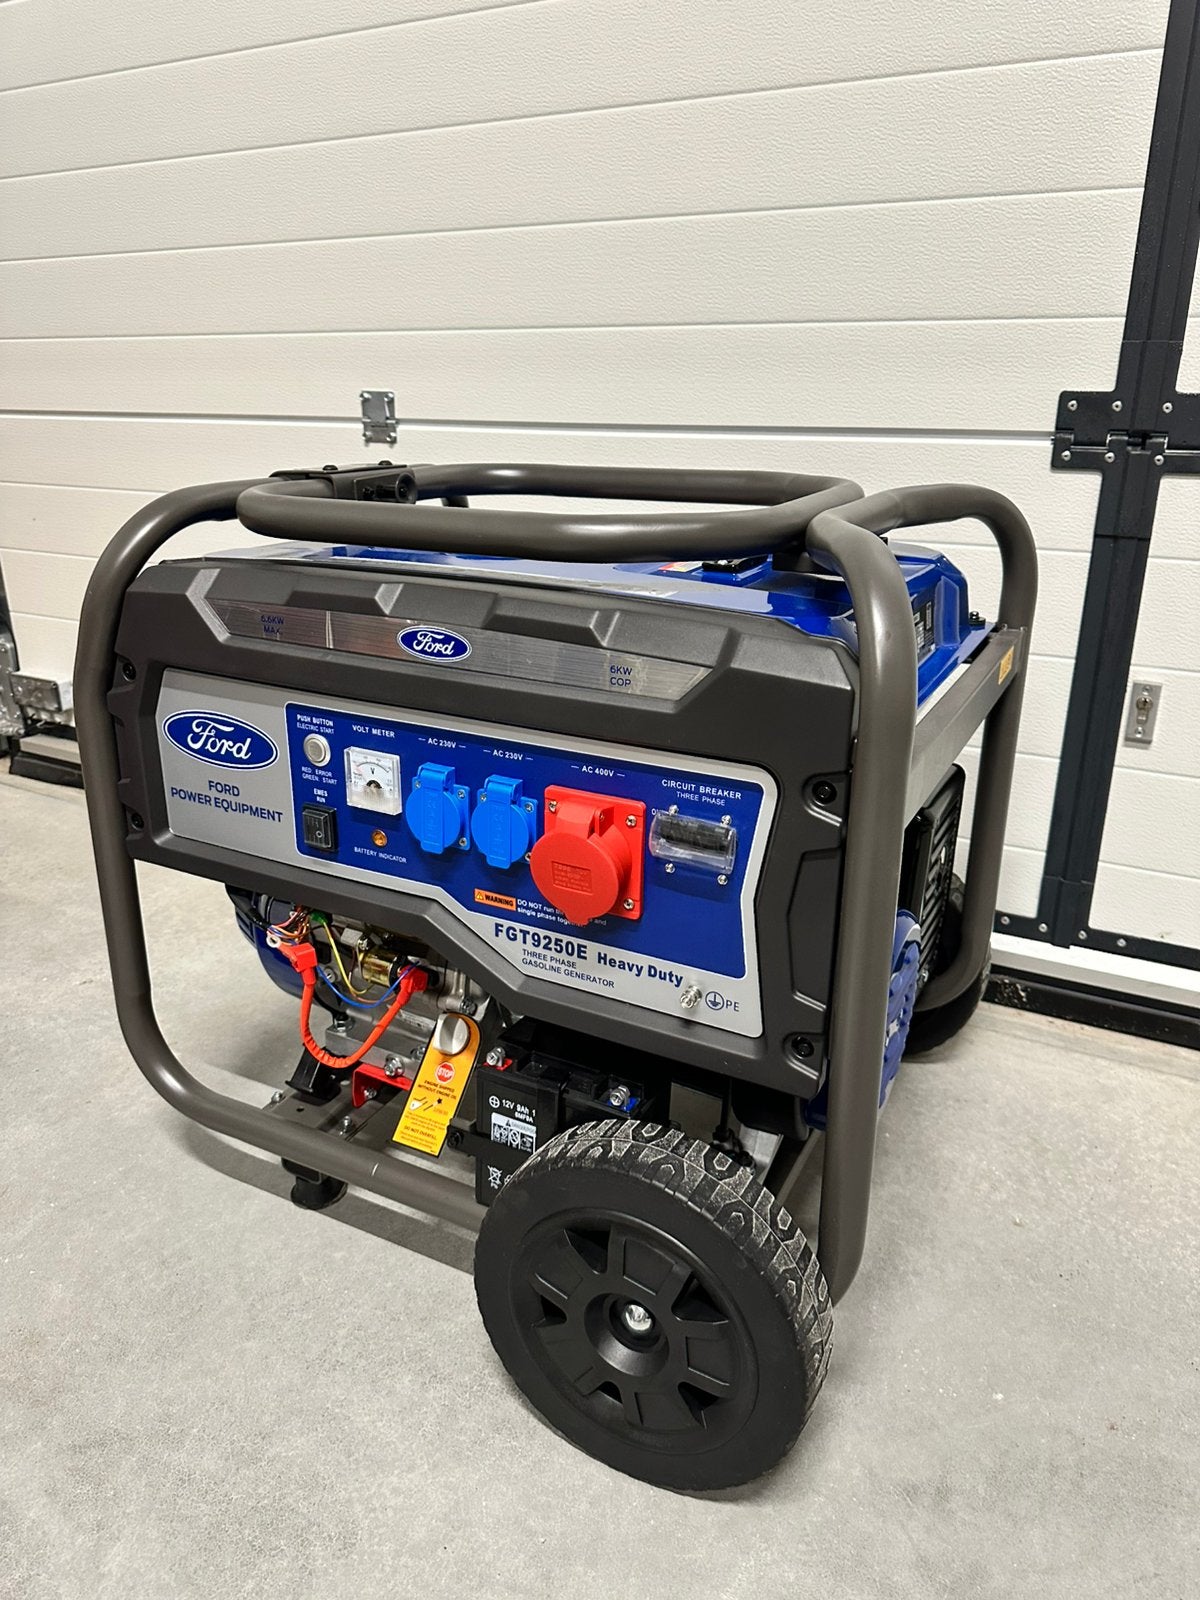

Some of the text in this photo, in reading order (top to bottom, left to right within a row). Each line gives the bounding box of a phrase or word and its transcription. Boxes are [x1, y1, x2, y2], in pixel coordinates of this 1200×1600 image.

[412, 630, 455, 656] Ford
[609, 664, 633, 676] 6KW
[609, 676, 632, 688] COP
[296, 714, 334, 727] PUSH BUTTON
[296, 722, 335, 734] ELECTRIC START
[352, 724, 395, 739] VOLT METER
[186, 718, 252, 761] Ford
[427, 737, 457, 750] AC 230V
[492, 748, 524, 761] AC 230V
[581, 765, 615, 778] AC 400V
[322, 776, 338, 785] START
[208, 779, 240, 797] FORD
[661, 779, 742, 800] CIRCUIT BREAKER
[170, 786, 284, 823] POWER EQUIPMENT
[676, 791, 726, 806] THREE PHASE
[354, 846, 407, 864] BATTERY INDICATOR
[484, 894, 514, 907] WARNING
[517, 899, 527, 907] DO
[528, 901, 542, 910] NOT
[517, 907, 536, 917] single
[536, 912, 556, 921] phase
[494, 922, 684, 988] FGT9250E Heavy Duty
[522, 948, 577, 969] THREE PHASE
[521, 957, 615, 988] GASOLINE GENERATOR
[725, 999, 740, 1012] PE
[437, 1067, 454, 1079] STOP
[501, 1099, 515, 1110] 12V
